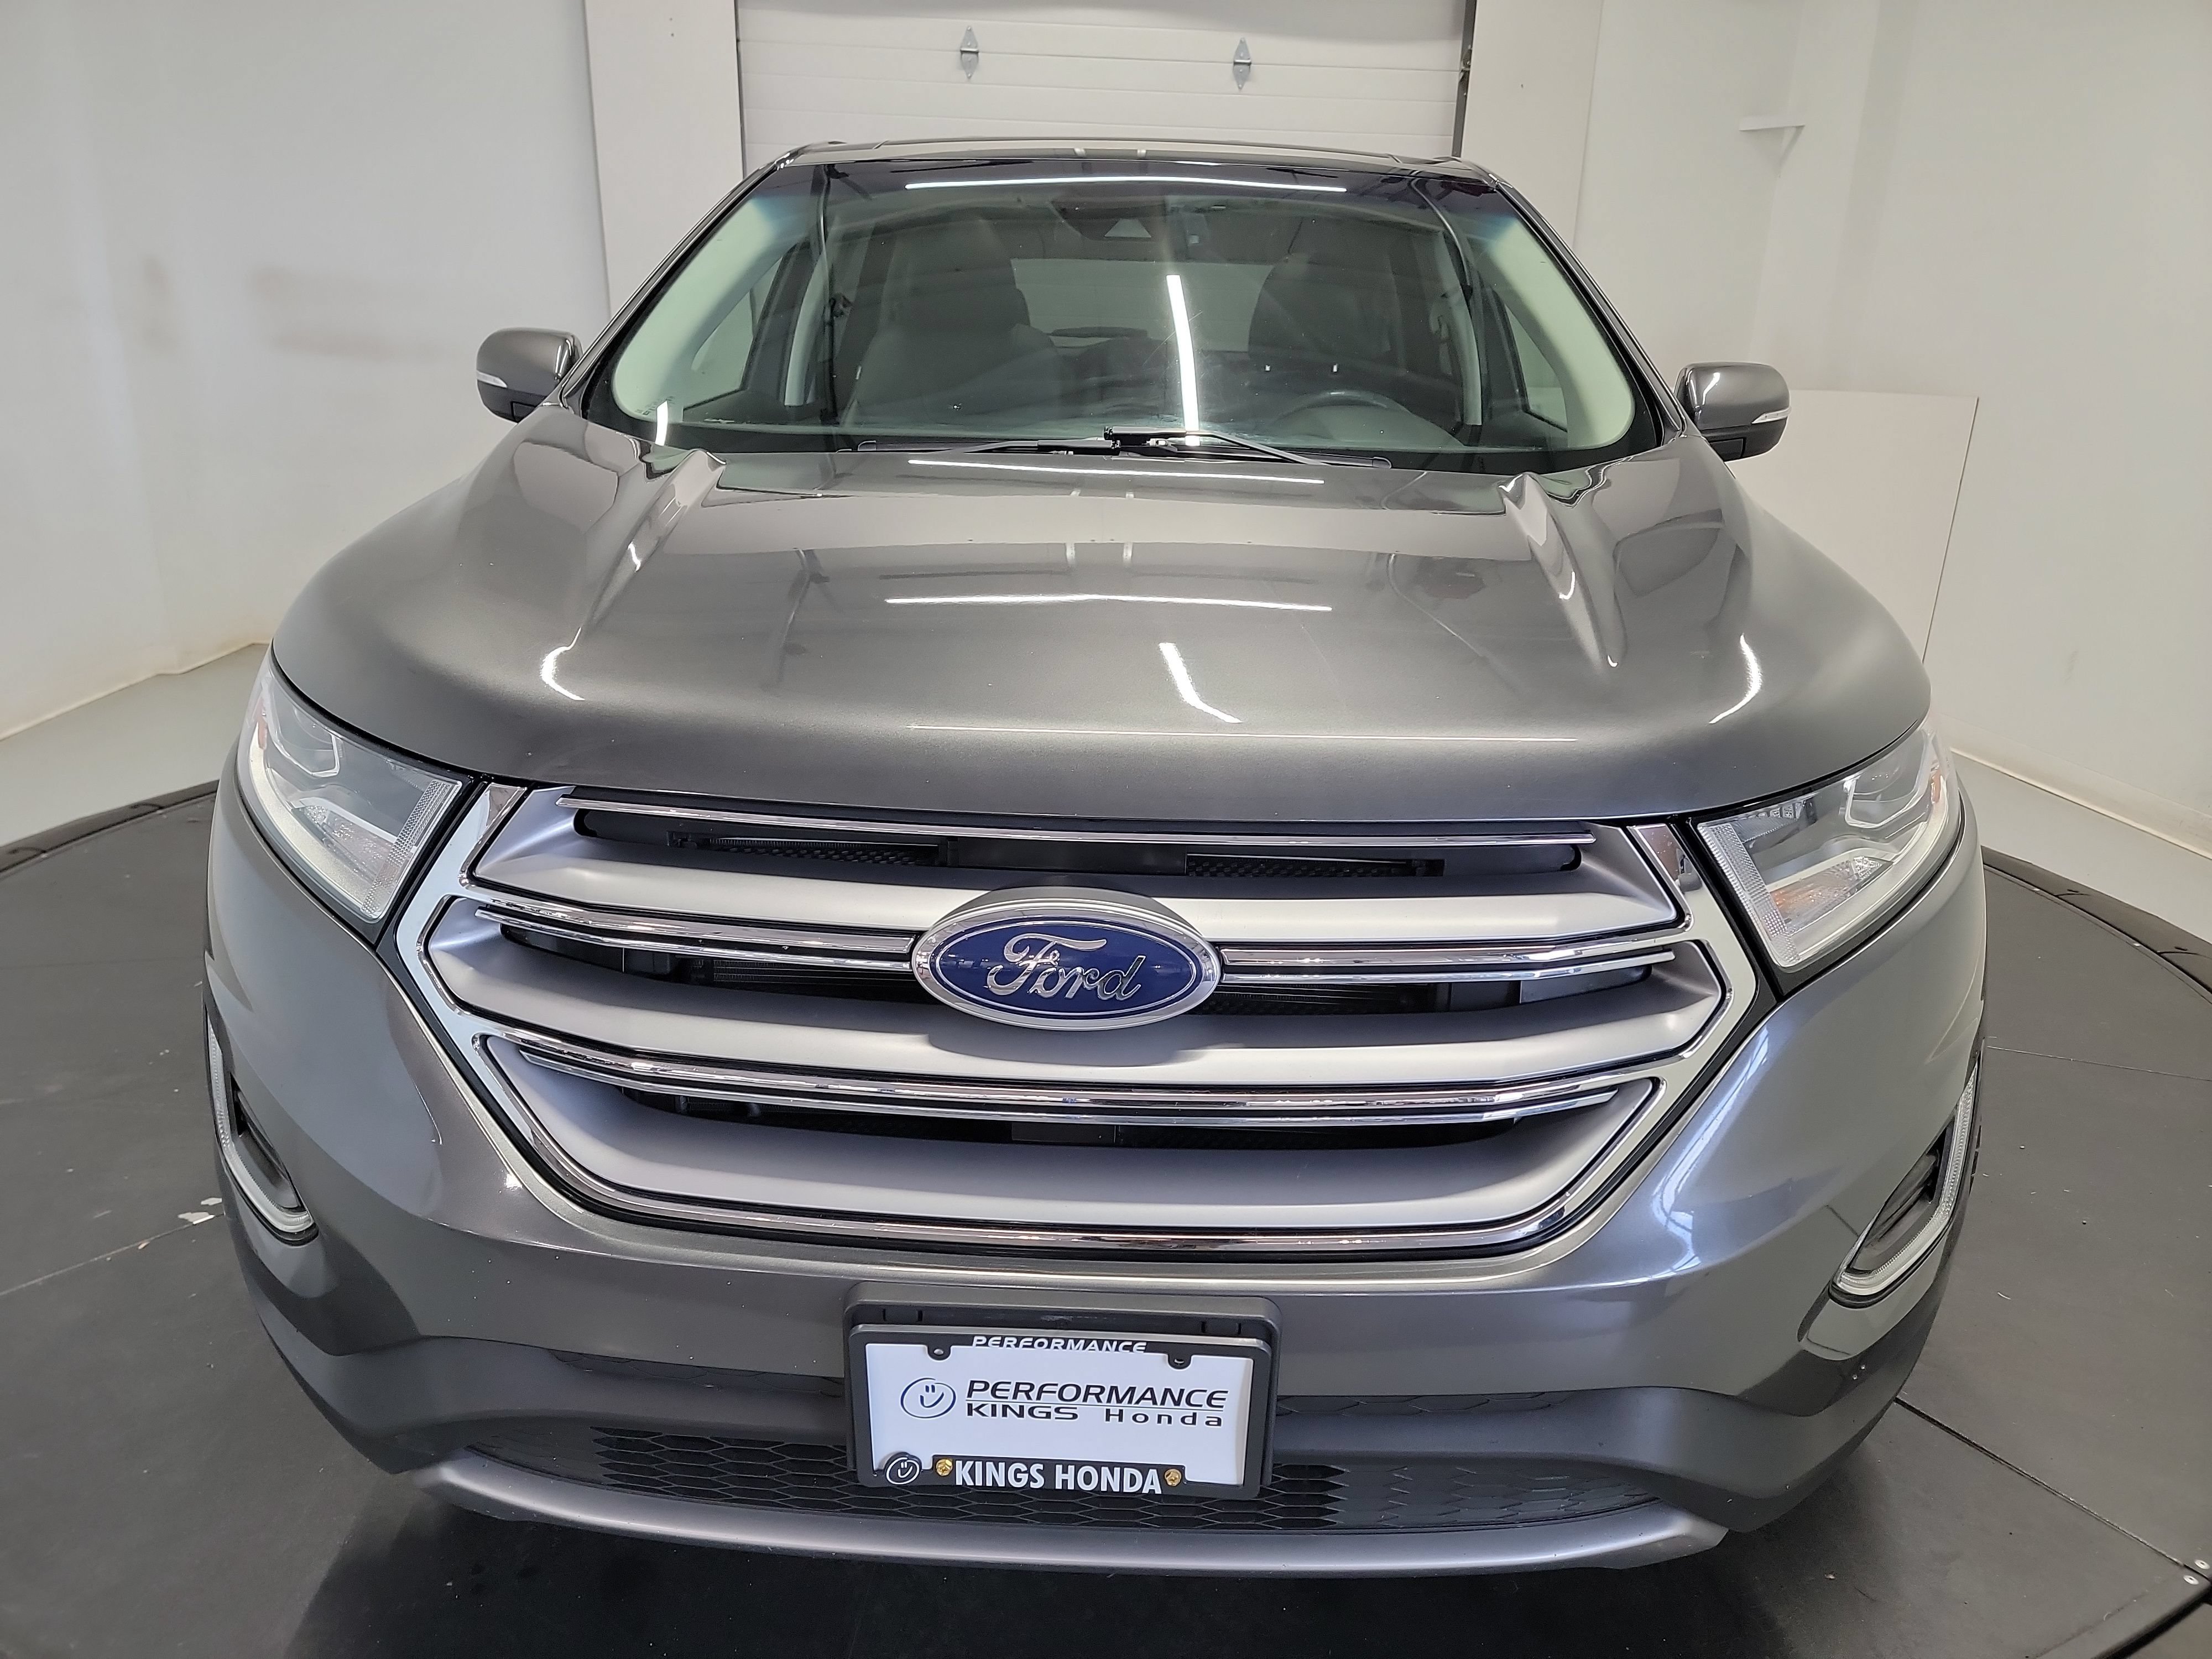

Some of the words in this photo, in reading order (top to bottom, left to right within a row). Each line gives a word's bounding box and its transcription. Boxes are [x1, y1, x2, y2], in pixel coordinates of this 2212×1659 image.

[987, 933, 1146, 1000] Ford
[973, 1337, 1147, 1352] PERFORMANCE
[967, 1380, 1228, 1408] PERFORMANCE
[967, 1404, 1078, 1420] KINGS
[1105, 1409, 1222, 1427] Honda
[956, 1462, 1045, 1489] KINGS
[1055, 1466, 1162, 1494] HONDA
